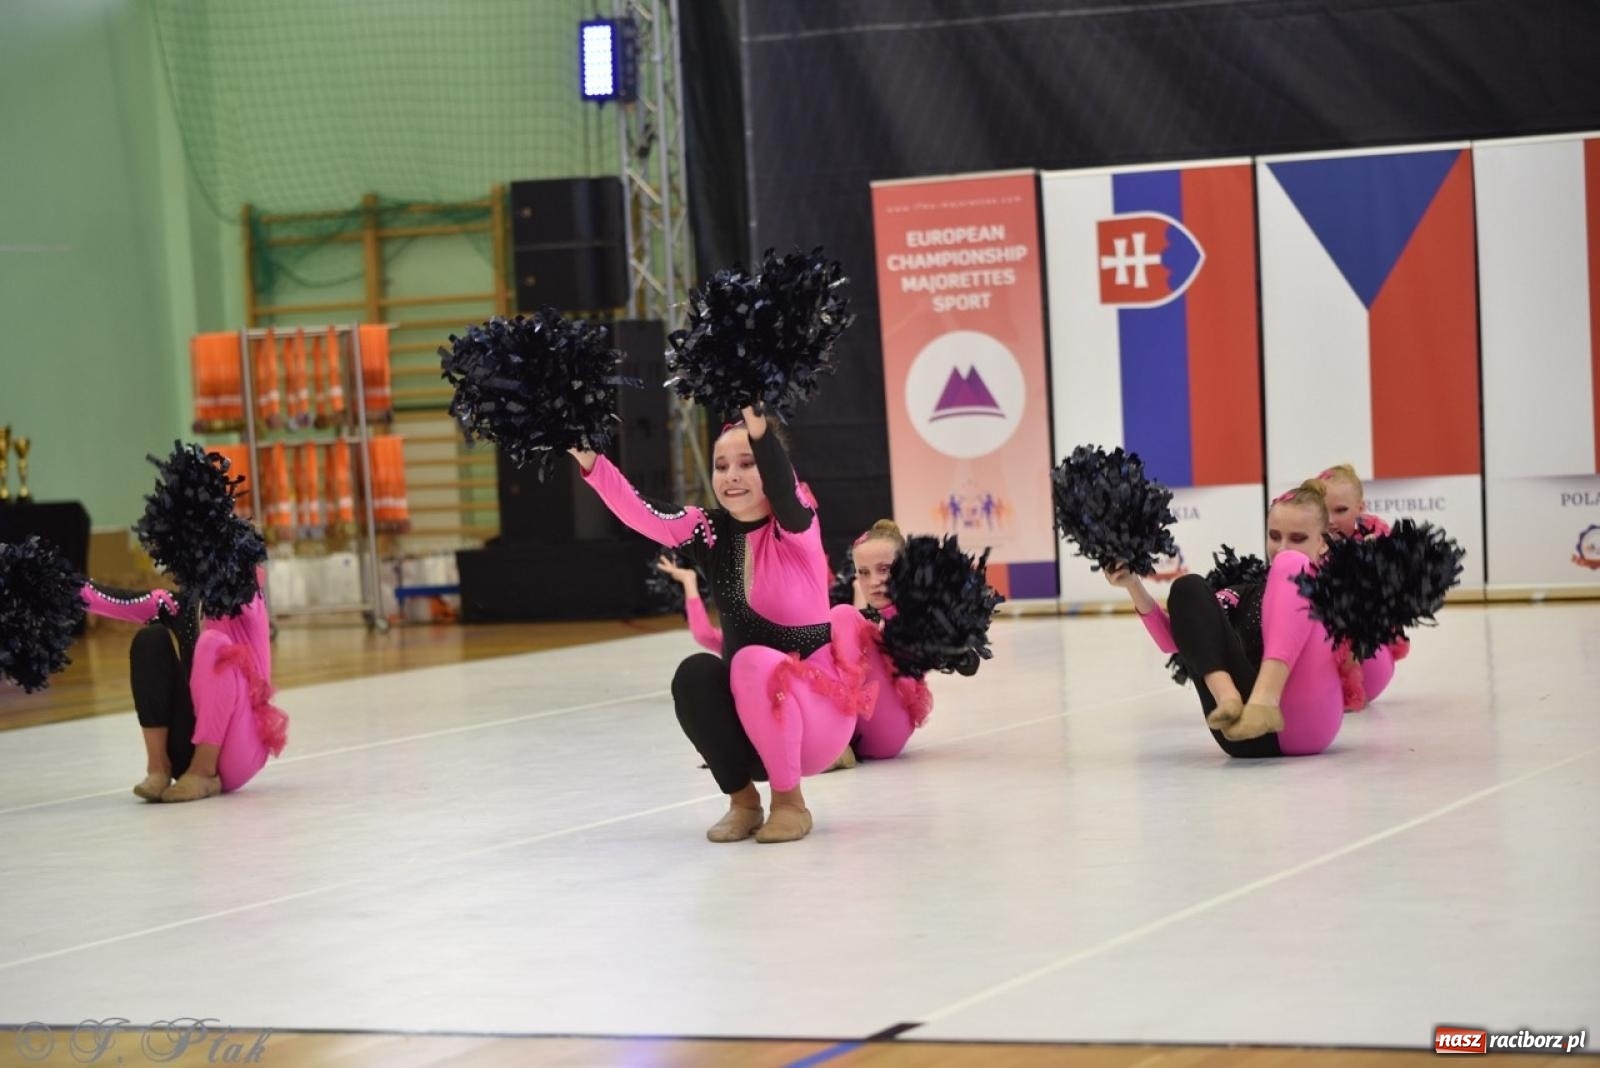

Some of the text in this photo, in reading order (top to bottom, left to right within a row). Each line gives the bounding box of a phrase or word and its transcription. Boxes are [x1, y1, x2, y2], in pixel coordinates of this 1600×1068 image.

[906, 224, 1005, 248] EUROPEAN
[886, 244, 1028, 272] CHAMPIONSHIP
[901, 268, 1016, 293] MAJORETTES
[932, 293, 992, 313] SPORT
